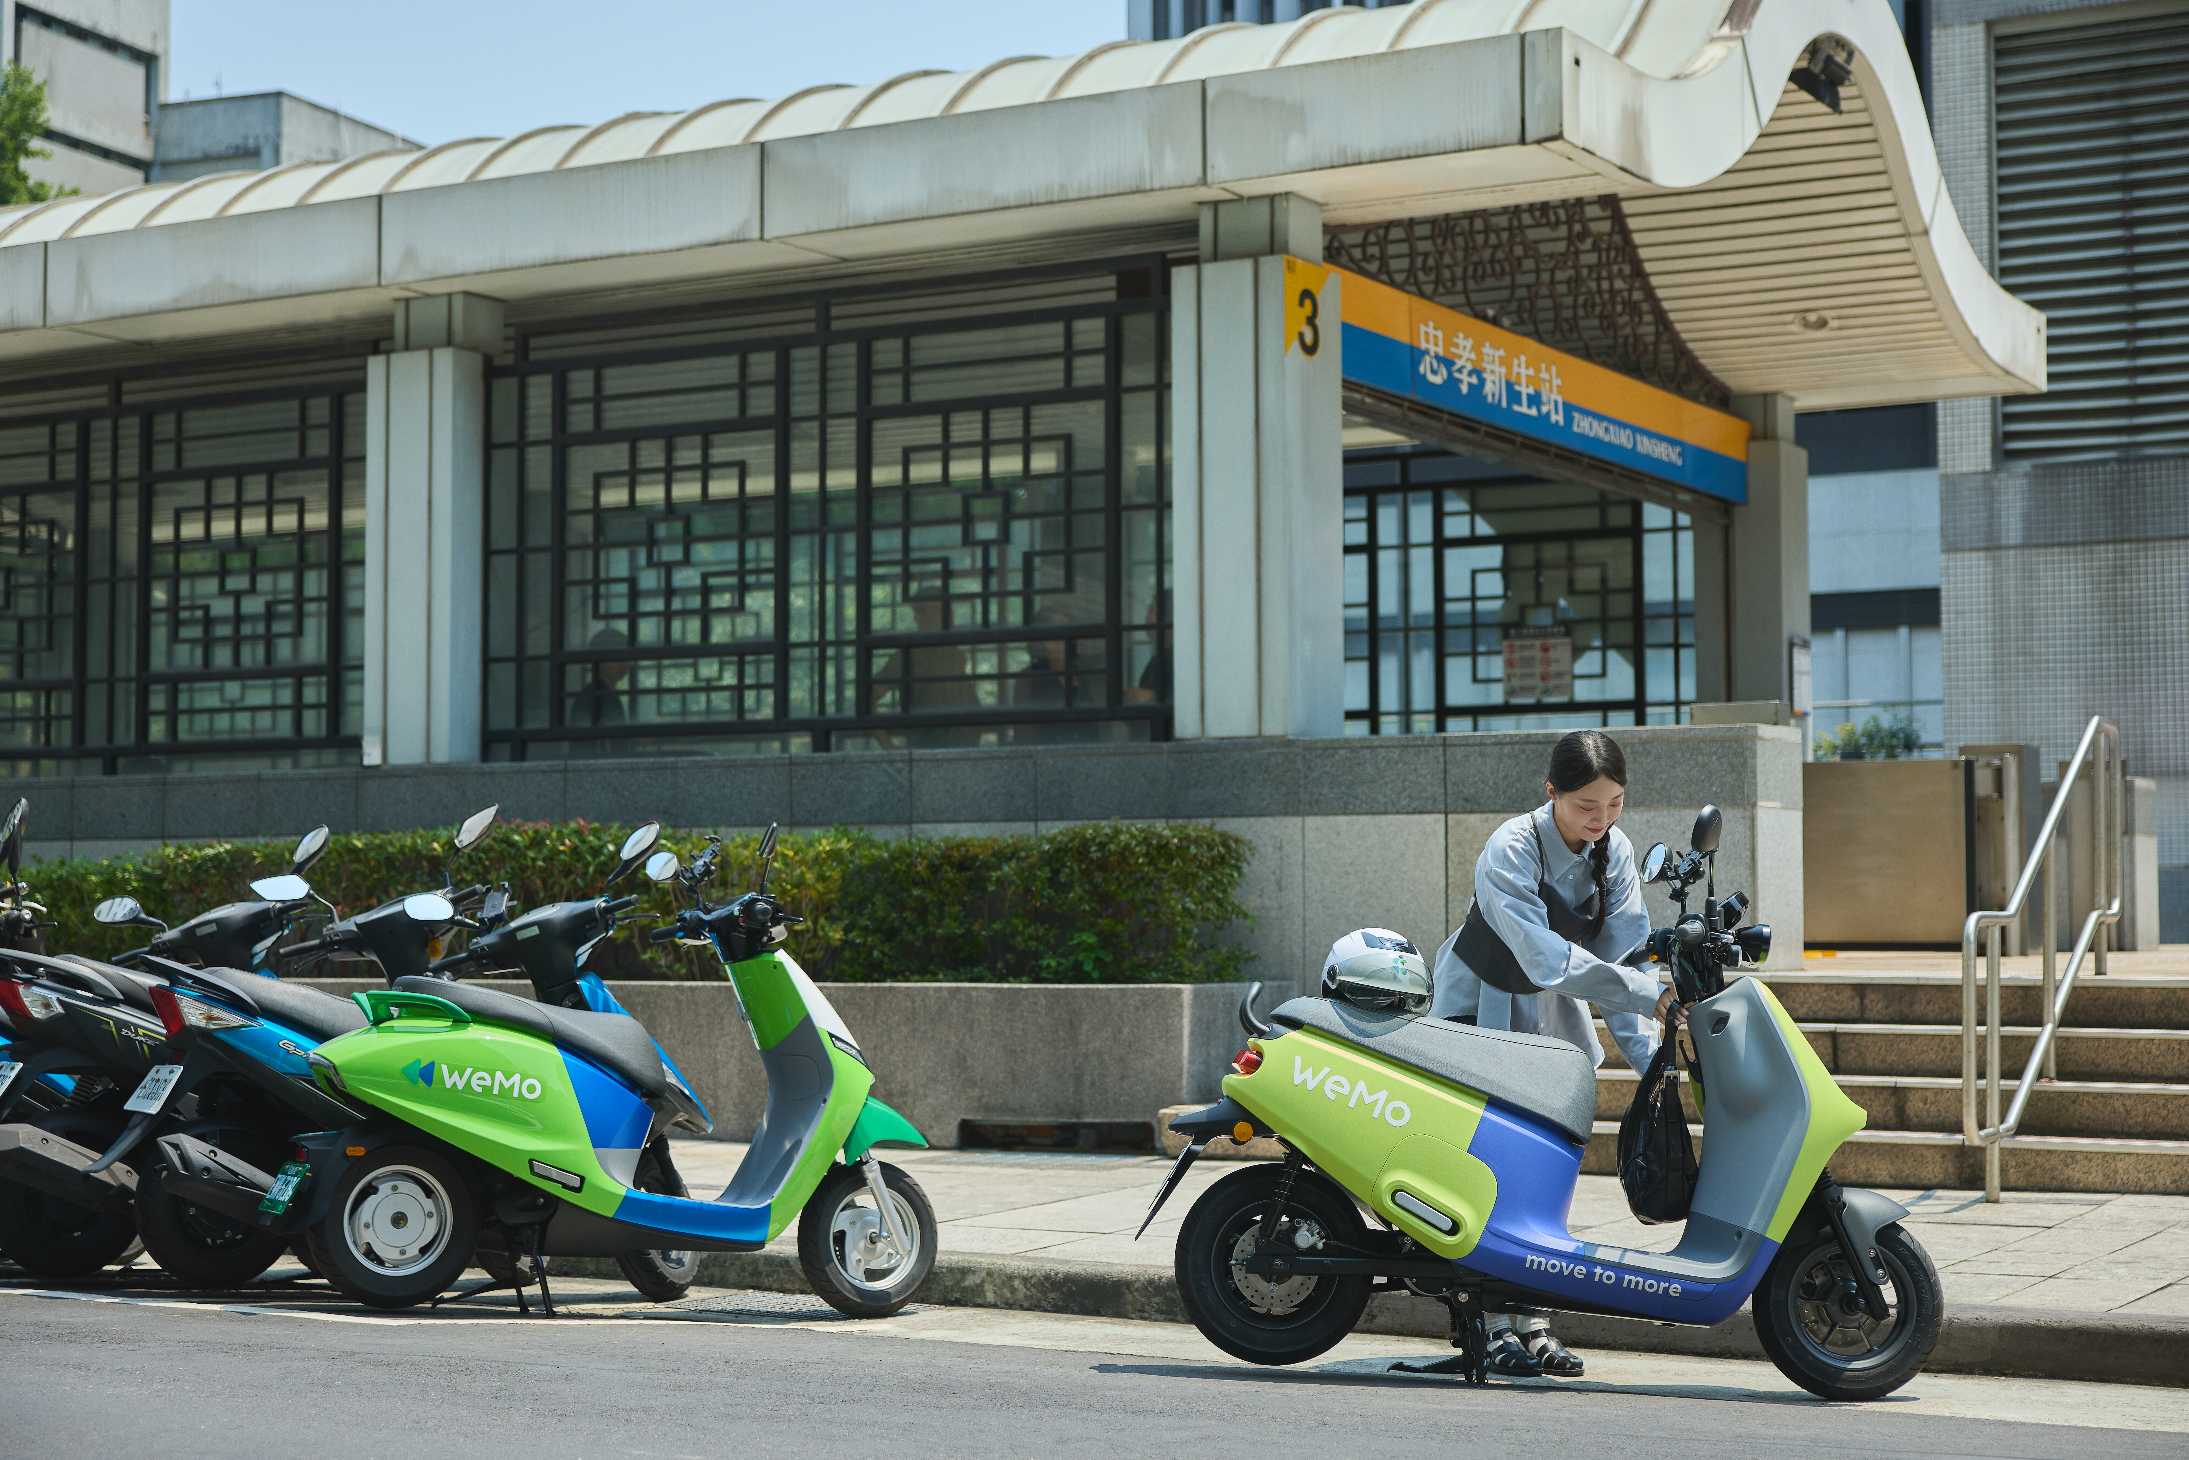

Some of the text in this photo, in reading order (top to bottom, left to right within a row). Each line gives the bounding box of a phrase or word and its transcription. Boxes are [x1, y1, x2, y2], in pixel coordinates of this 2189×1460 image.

[1298, 288, 1320, 356] 3
[1418, 320, 1565, 427] 忠孝新生站
[1571, 411, 1683, 467] ZHONGXIAO XINSHENG
[441, 1063, 542, 1100] WeMo
[1293, 1055, 1412, 1128] WeMo
[1525, 1254, 1682, 1297] move to more
